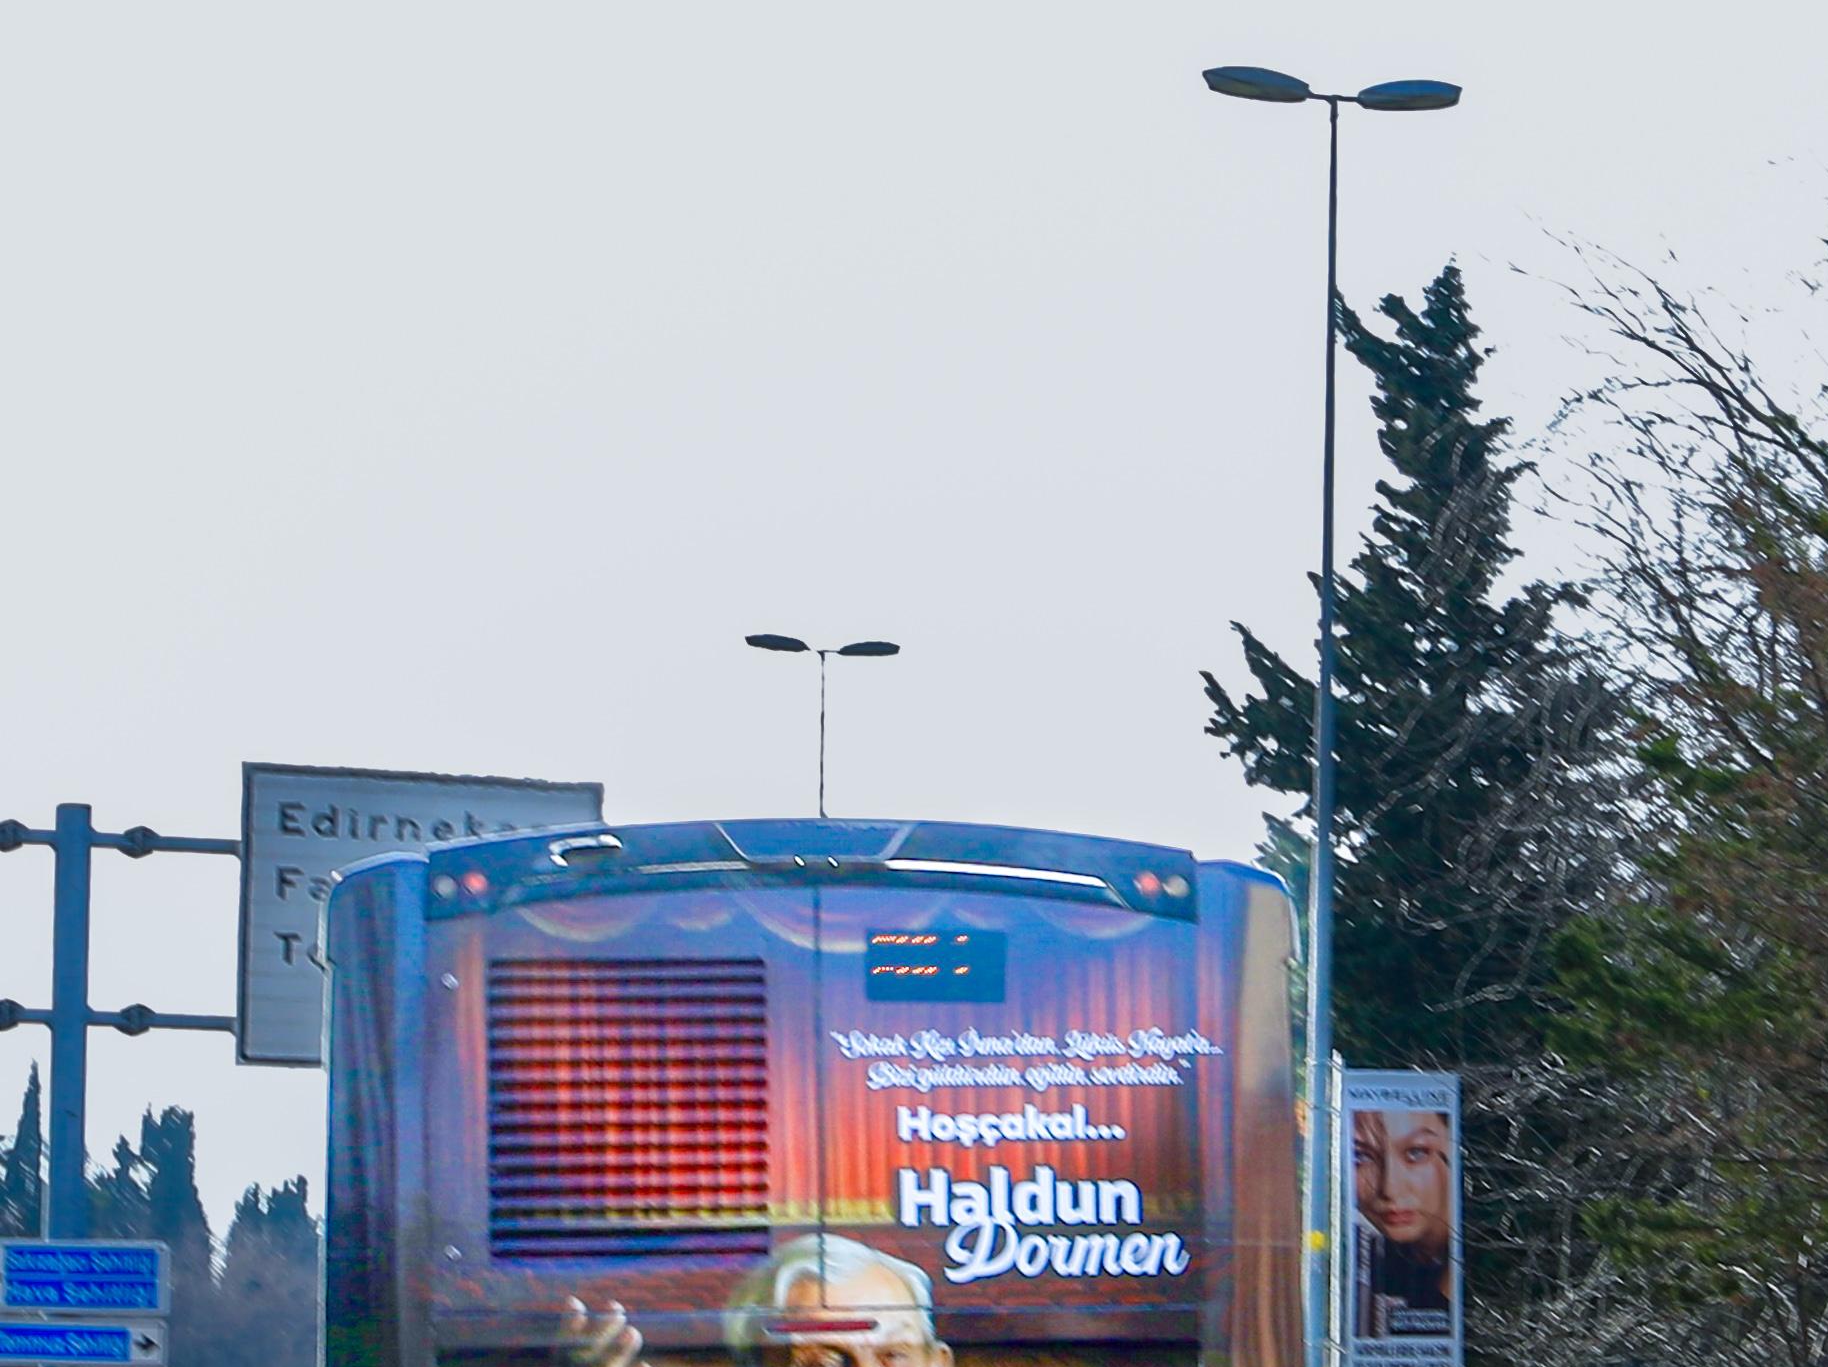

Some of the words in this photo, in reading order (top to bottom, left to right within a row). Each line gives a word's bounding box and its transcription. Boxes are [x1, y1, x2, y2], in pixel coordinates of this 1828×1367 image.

[896, 1104, 1127, 1148] Hoşçakal...
[899, 1165, 1143, 1228] Haldun
[943, 1220, 1191, 1284] Dormen
